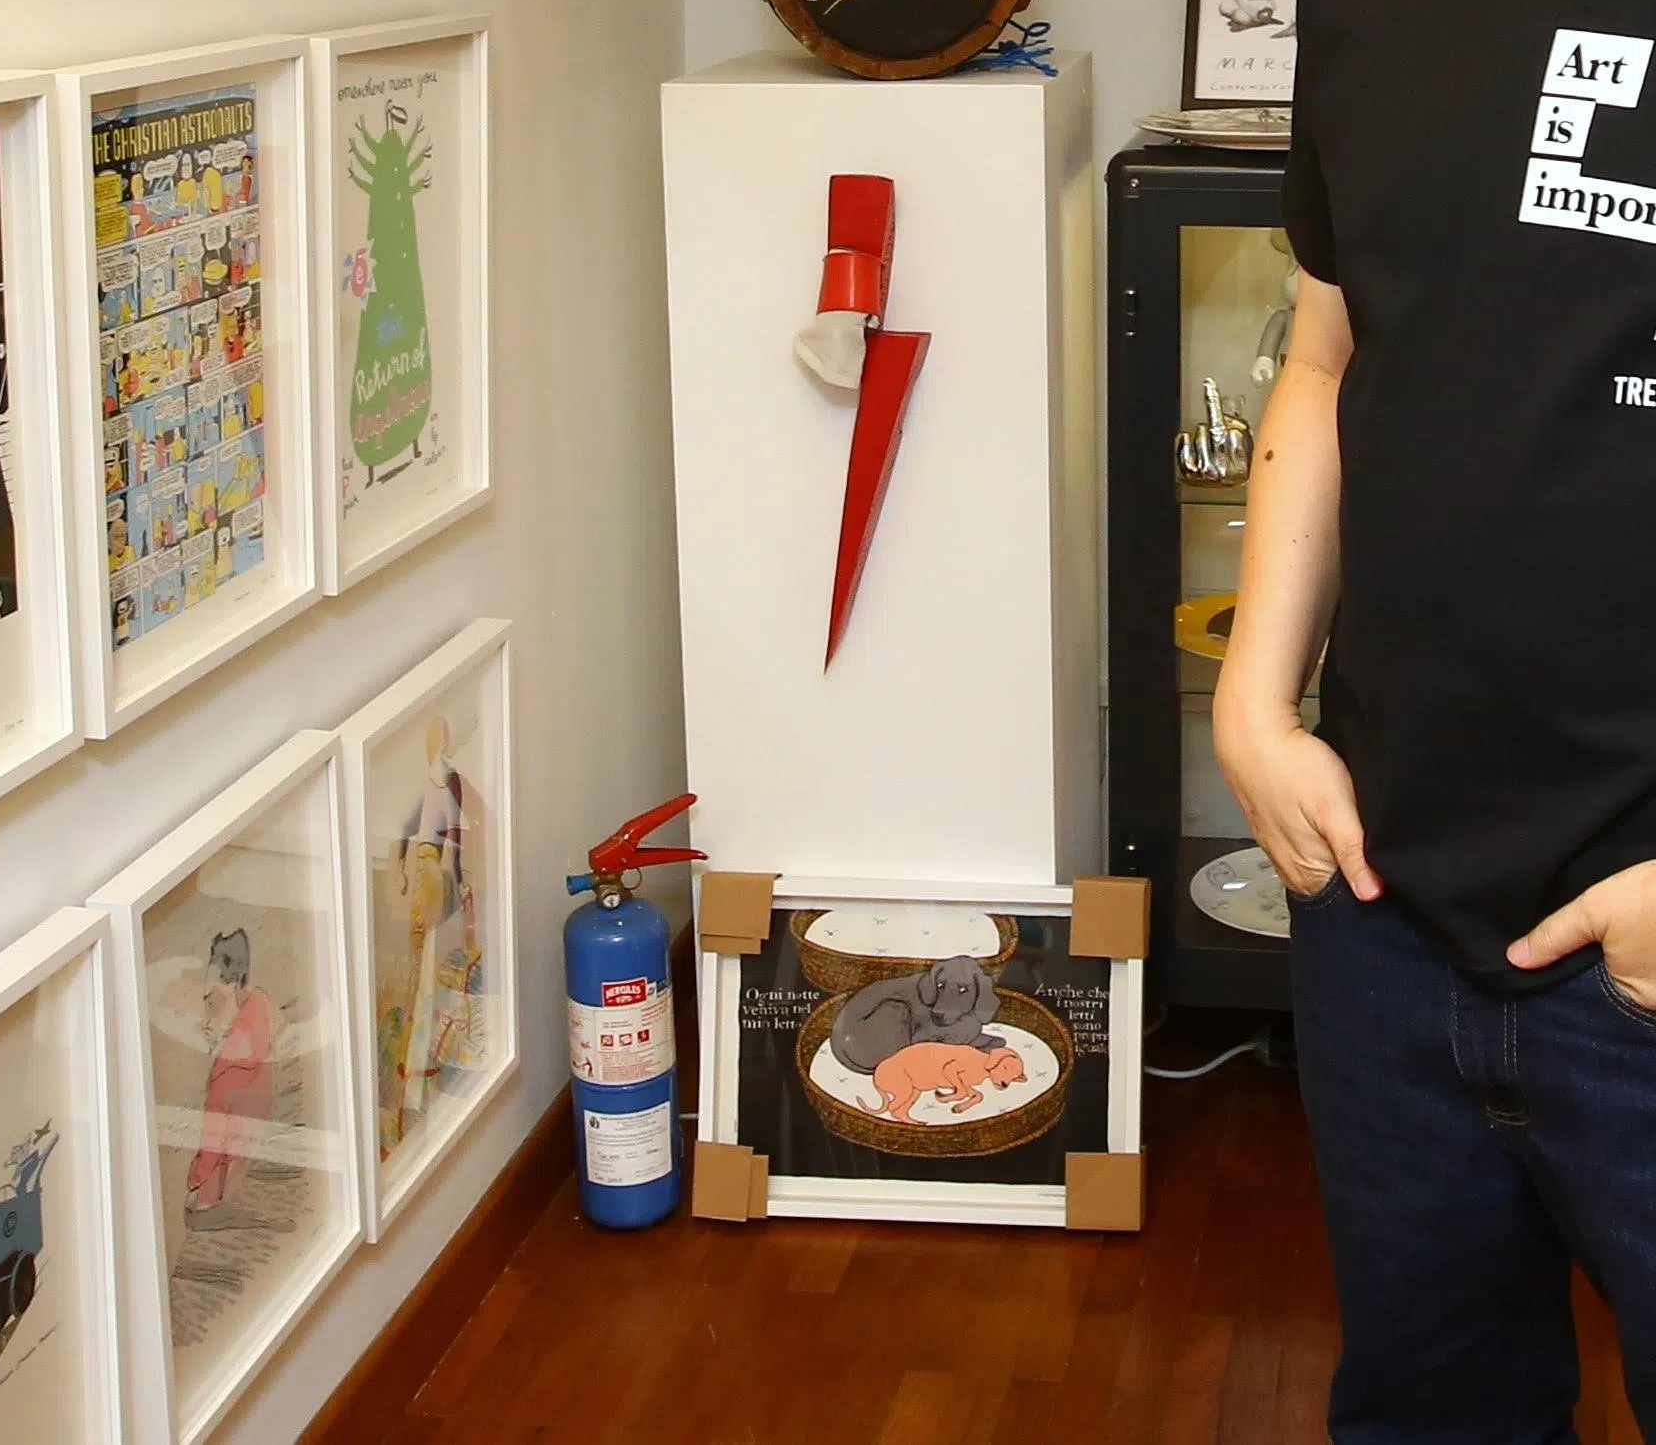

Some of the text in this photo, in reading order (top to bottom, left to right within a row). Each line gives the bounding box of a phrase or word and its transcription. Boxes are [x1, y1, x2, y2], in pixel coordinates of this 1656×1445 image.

[1556, 43, 1628, 85] Art
[113, 116, 178, 161] CHRISTIAN
[180, 101, 253, 147] ASTRONAUTS
[1544, 105, 1574, 145] is
[746, 987, 782, 1007] Ogni
[1073, 1022, 1102, 1031] sono
